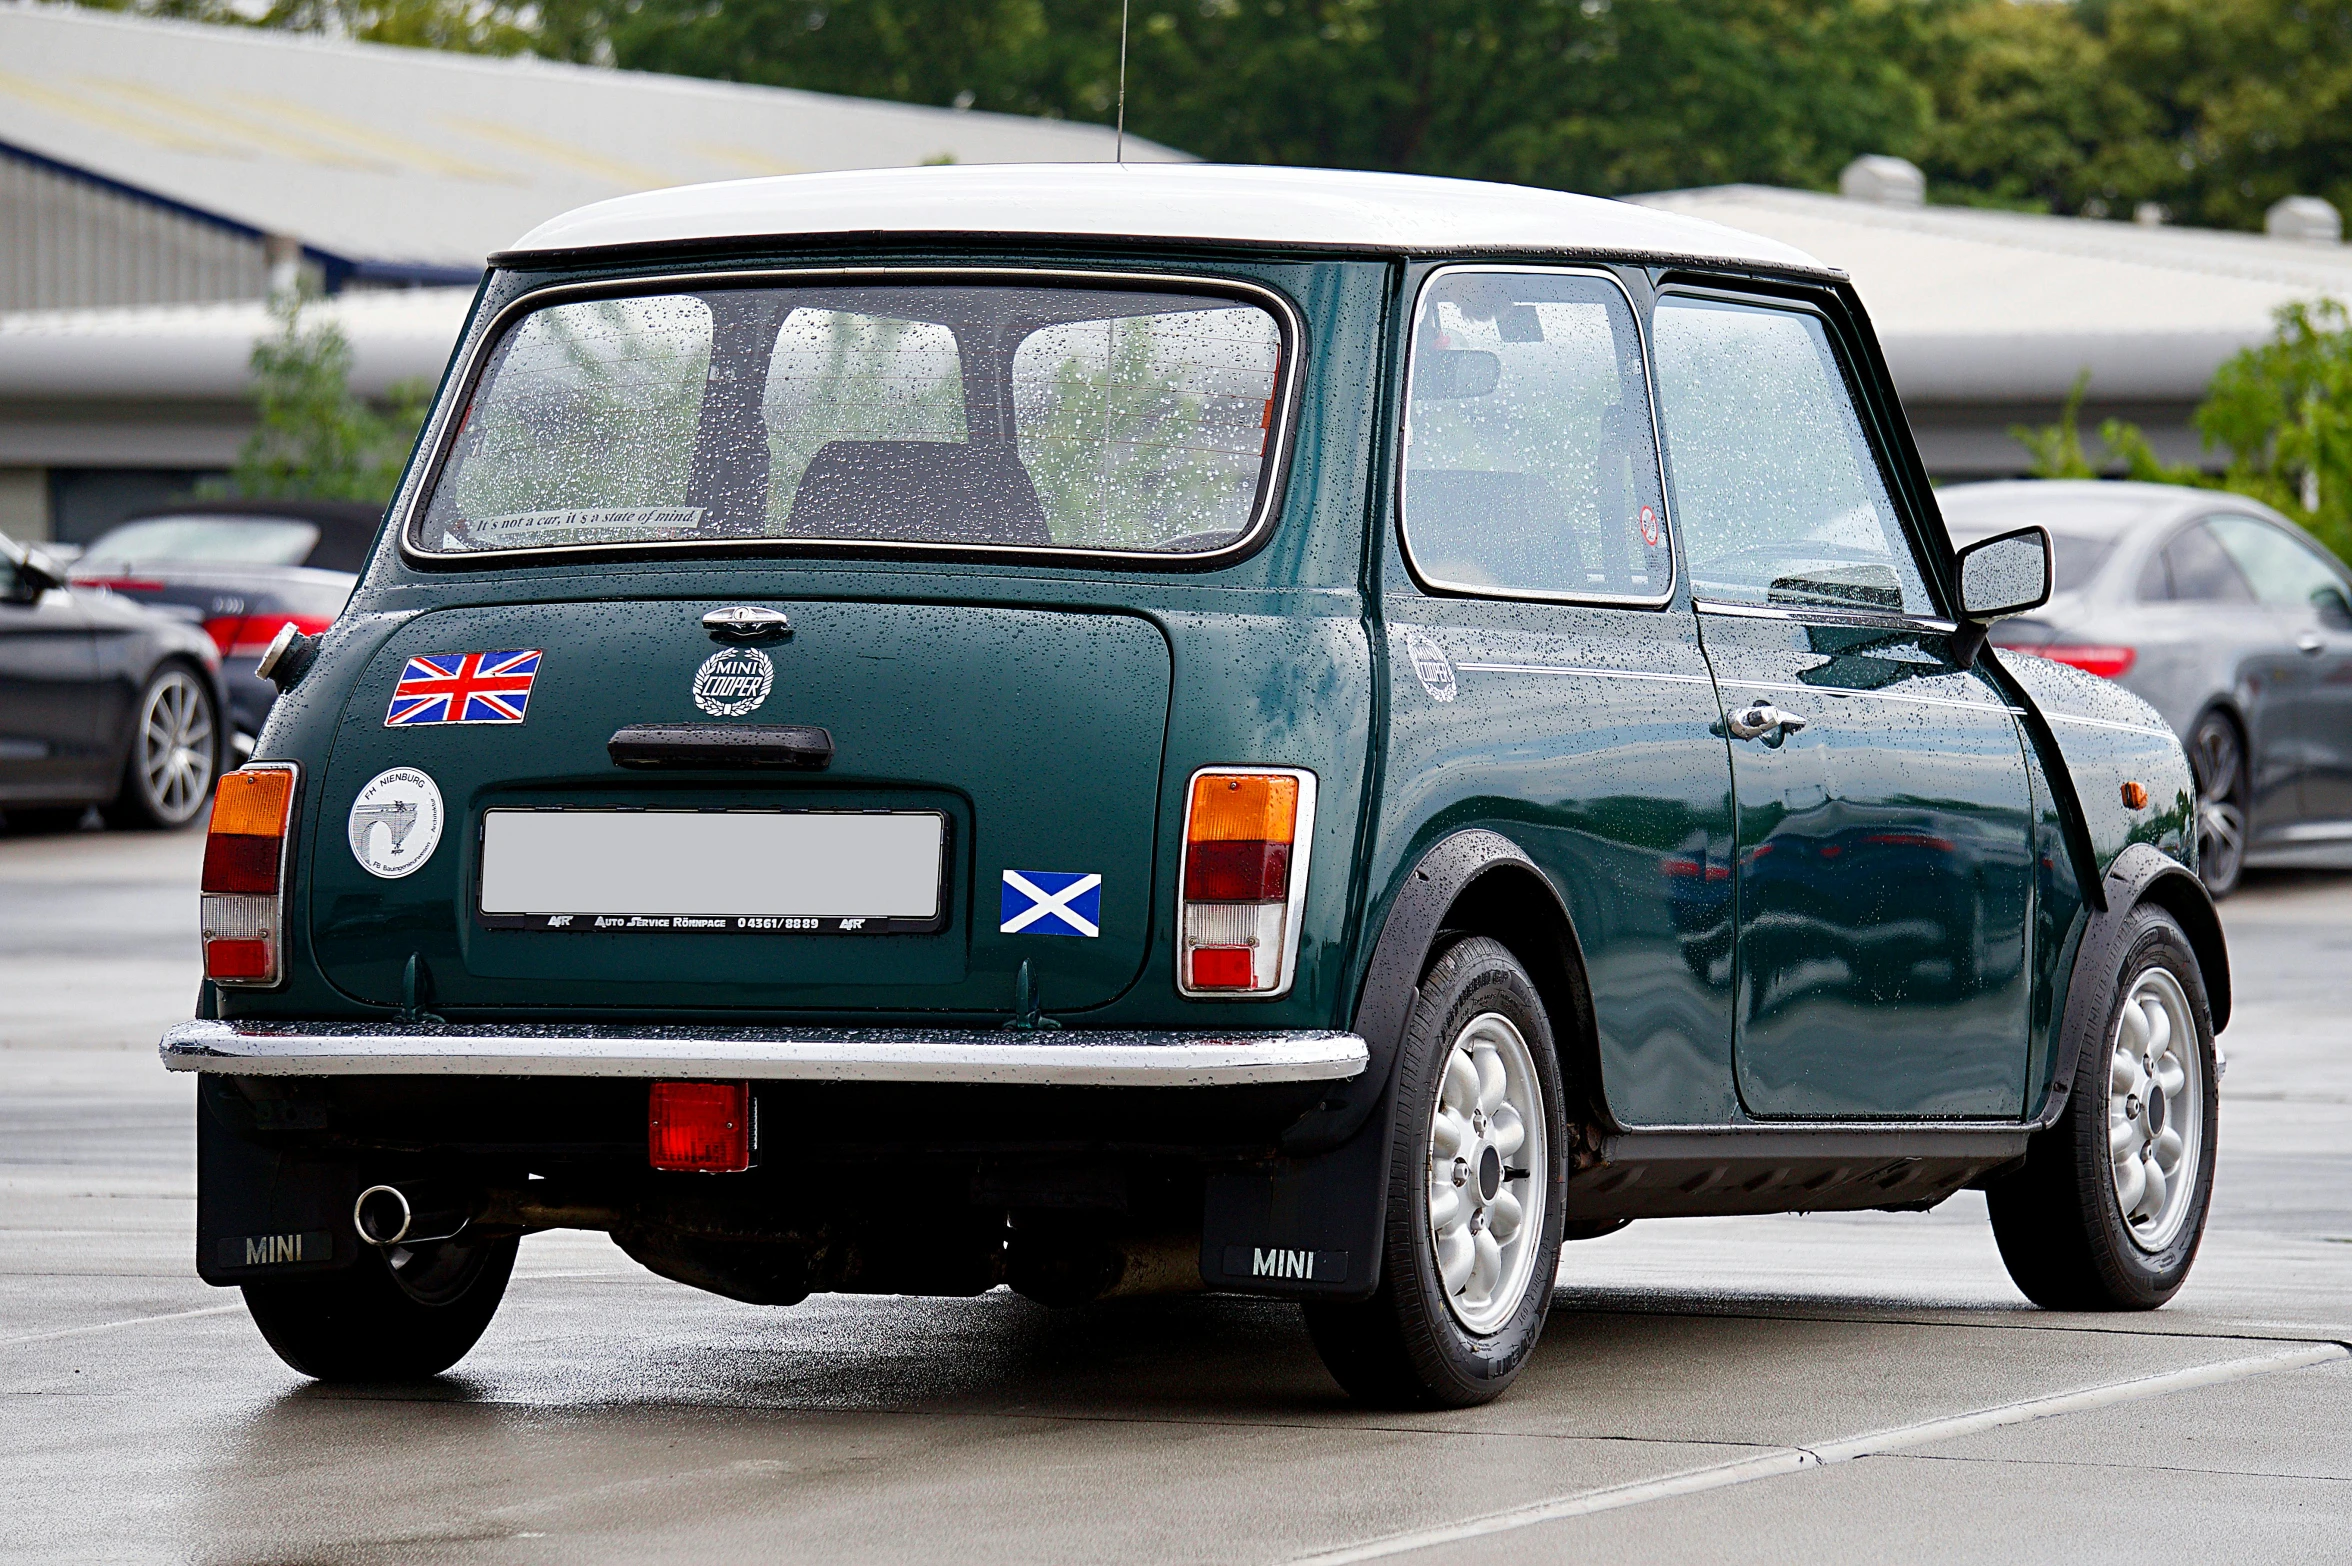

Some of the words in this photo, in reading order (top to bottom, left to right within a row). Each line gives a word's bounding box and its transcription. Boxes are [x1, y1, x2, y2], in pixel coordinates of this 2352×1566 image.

[501, 517, 524, 529] not
[525, 517, 534, 526] a
[590, 514, 600, 522] a
[601, 510, 636, 522] state
[637, 509, 657, 525] of
[715, 661, 759, 675] MINI
[701, 676, 764, 697] COOPER
[364, 786, 377, 800] FH
[380, 773, 426, 789] NIENBURG
[372, 861, 381, 869] FB
[626, 916, 670, 928] SERVICE
[246, 1234, 302, 1265] MINI
[1252, 1247, 1314, 1279] MINI
